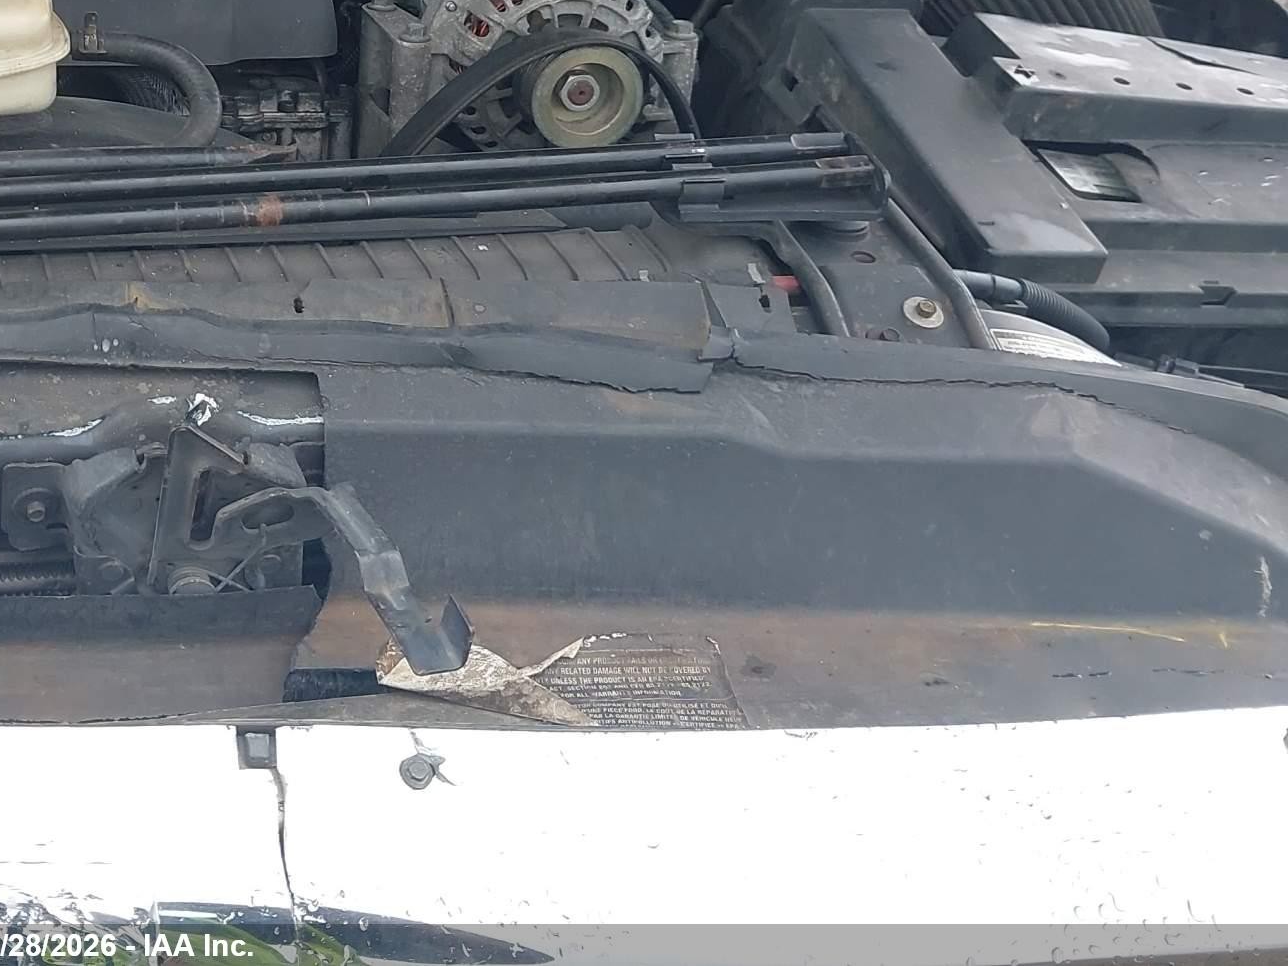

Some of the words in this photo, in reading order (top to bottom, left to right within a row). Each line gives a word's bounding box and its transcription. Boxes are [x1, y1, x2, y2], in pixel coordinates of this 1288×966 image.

[561, 667, 591, 675] RELATED
[592, 666, 622, 675] DAMAGE
[623, 666, 640, 674] WILL
[669, 665, 701, 674] OVERED
[550, 677, 578, 685] UNLESS
[579, 676, 592, 685] THE
[593, 675, 626, 684] PRODUCT
